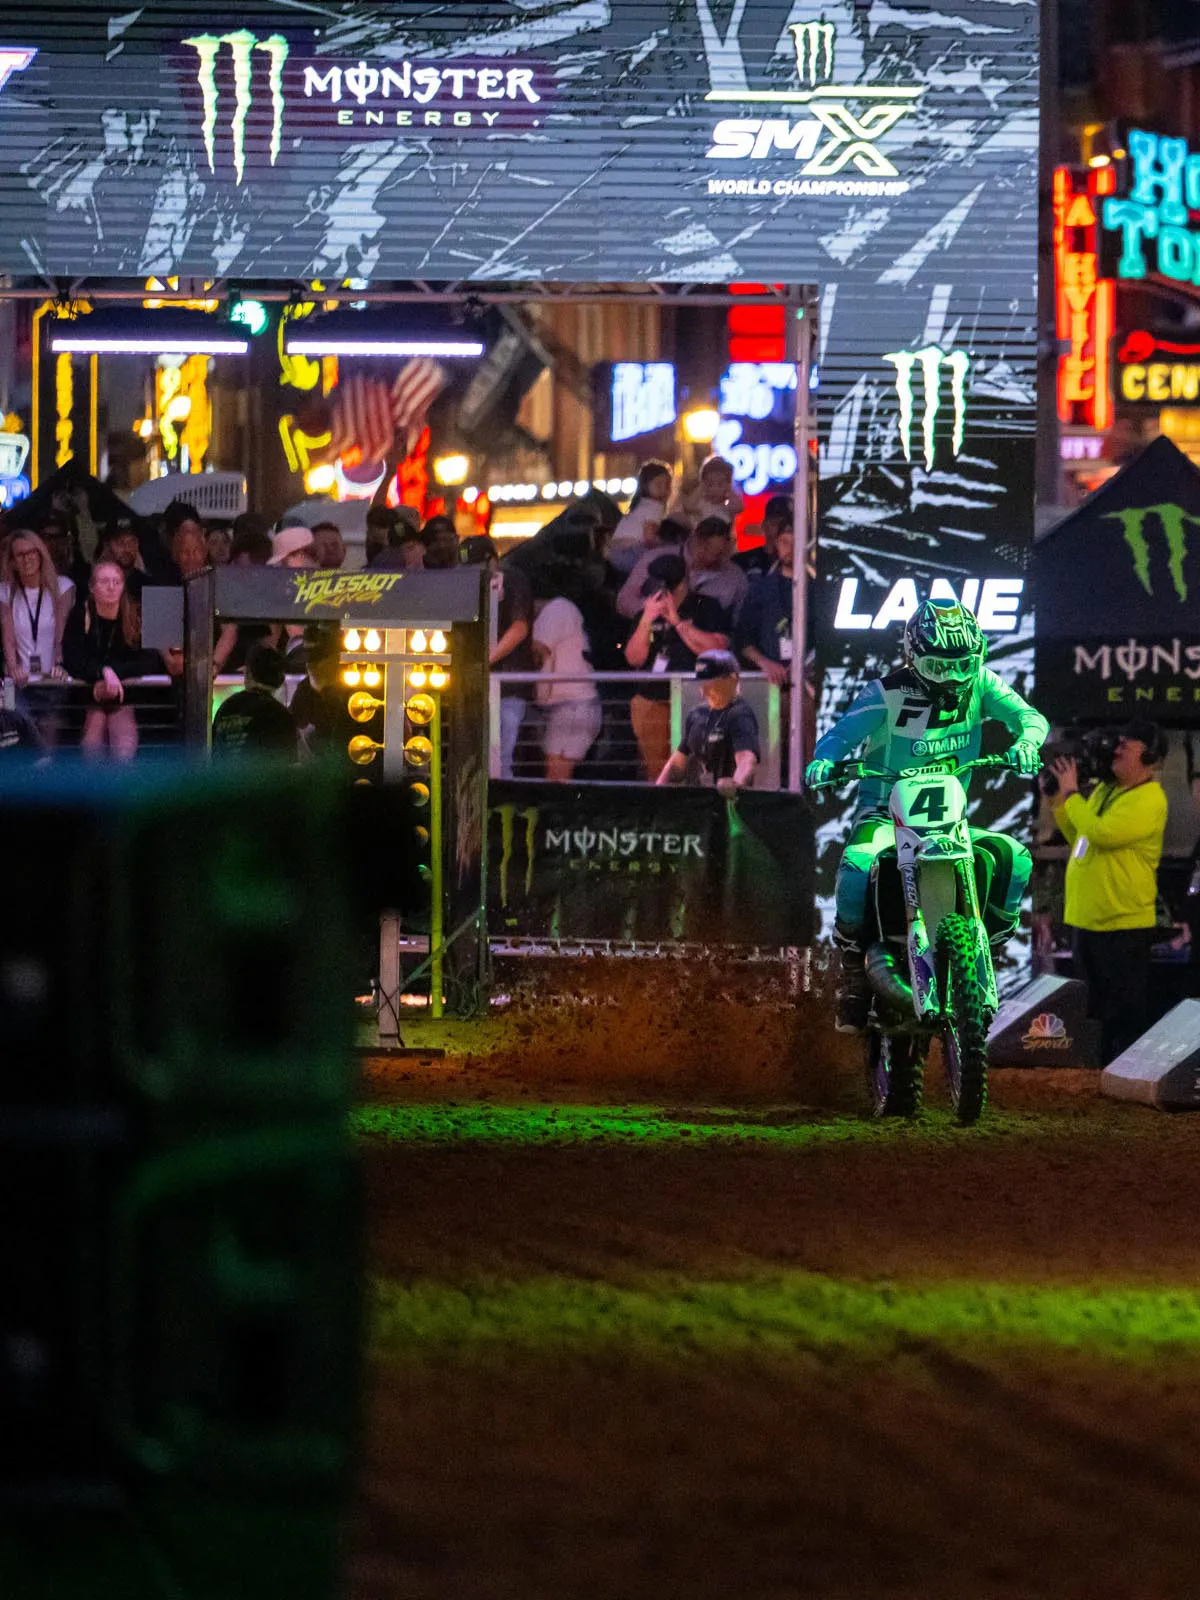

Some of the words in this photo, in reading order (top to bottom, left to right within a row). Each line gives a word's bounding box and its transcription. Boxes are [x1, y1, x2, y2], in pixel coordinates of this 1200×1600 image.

[303, 61, 541, 104] MONSTER
[337, 109, 500, 126] ENERGY
[704, 104, 917, 176] SMX
[707, 179, 771, 196] WORLD
[773, 180, 910, 196] CHAMPIONSHIP
[294, 573, 403, 604] HOLESHOT
[928, 734, 971, 754] YAMAHA
[908, 786, 949, 823] 4
[545, 826, 705, 858] MONSTER
